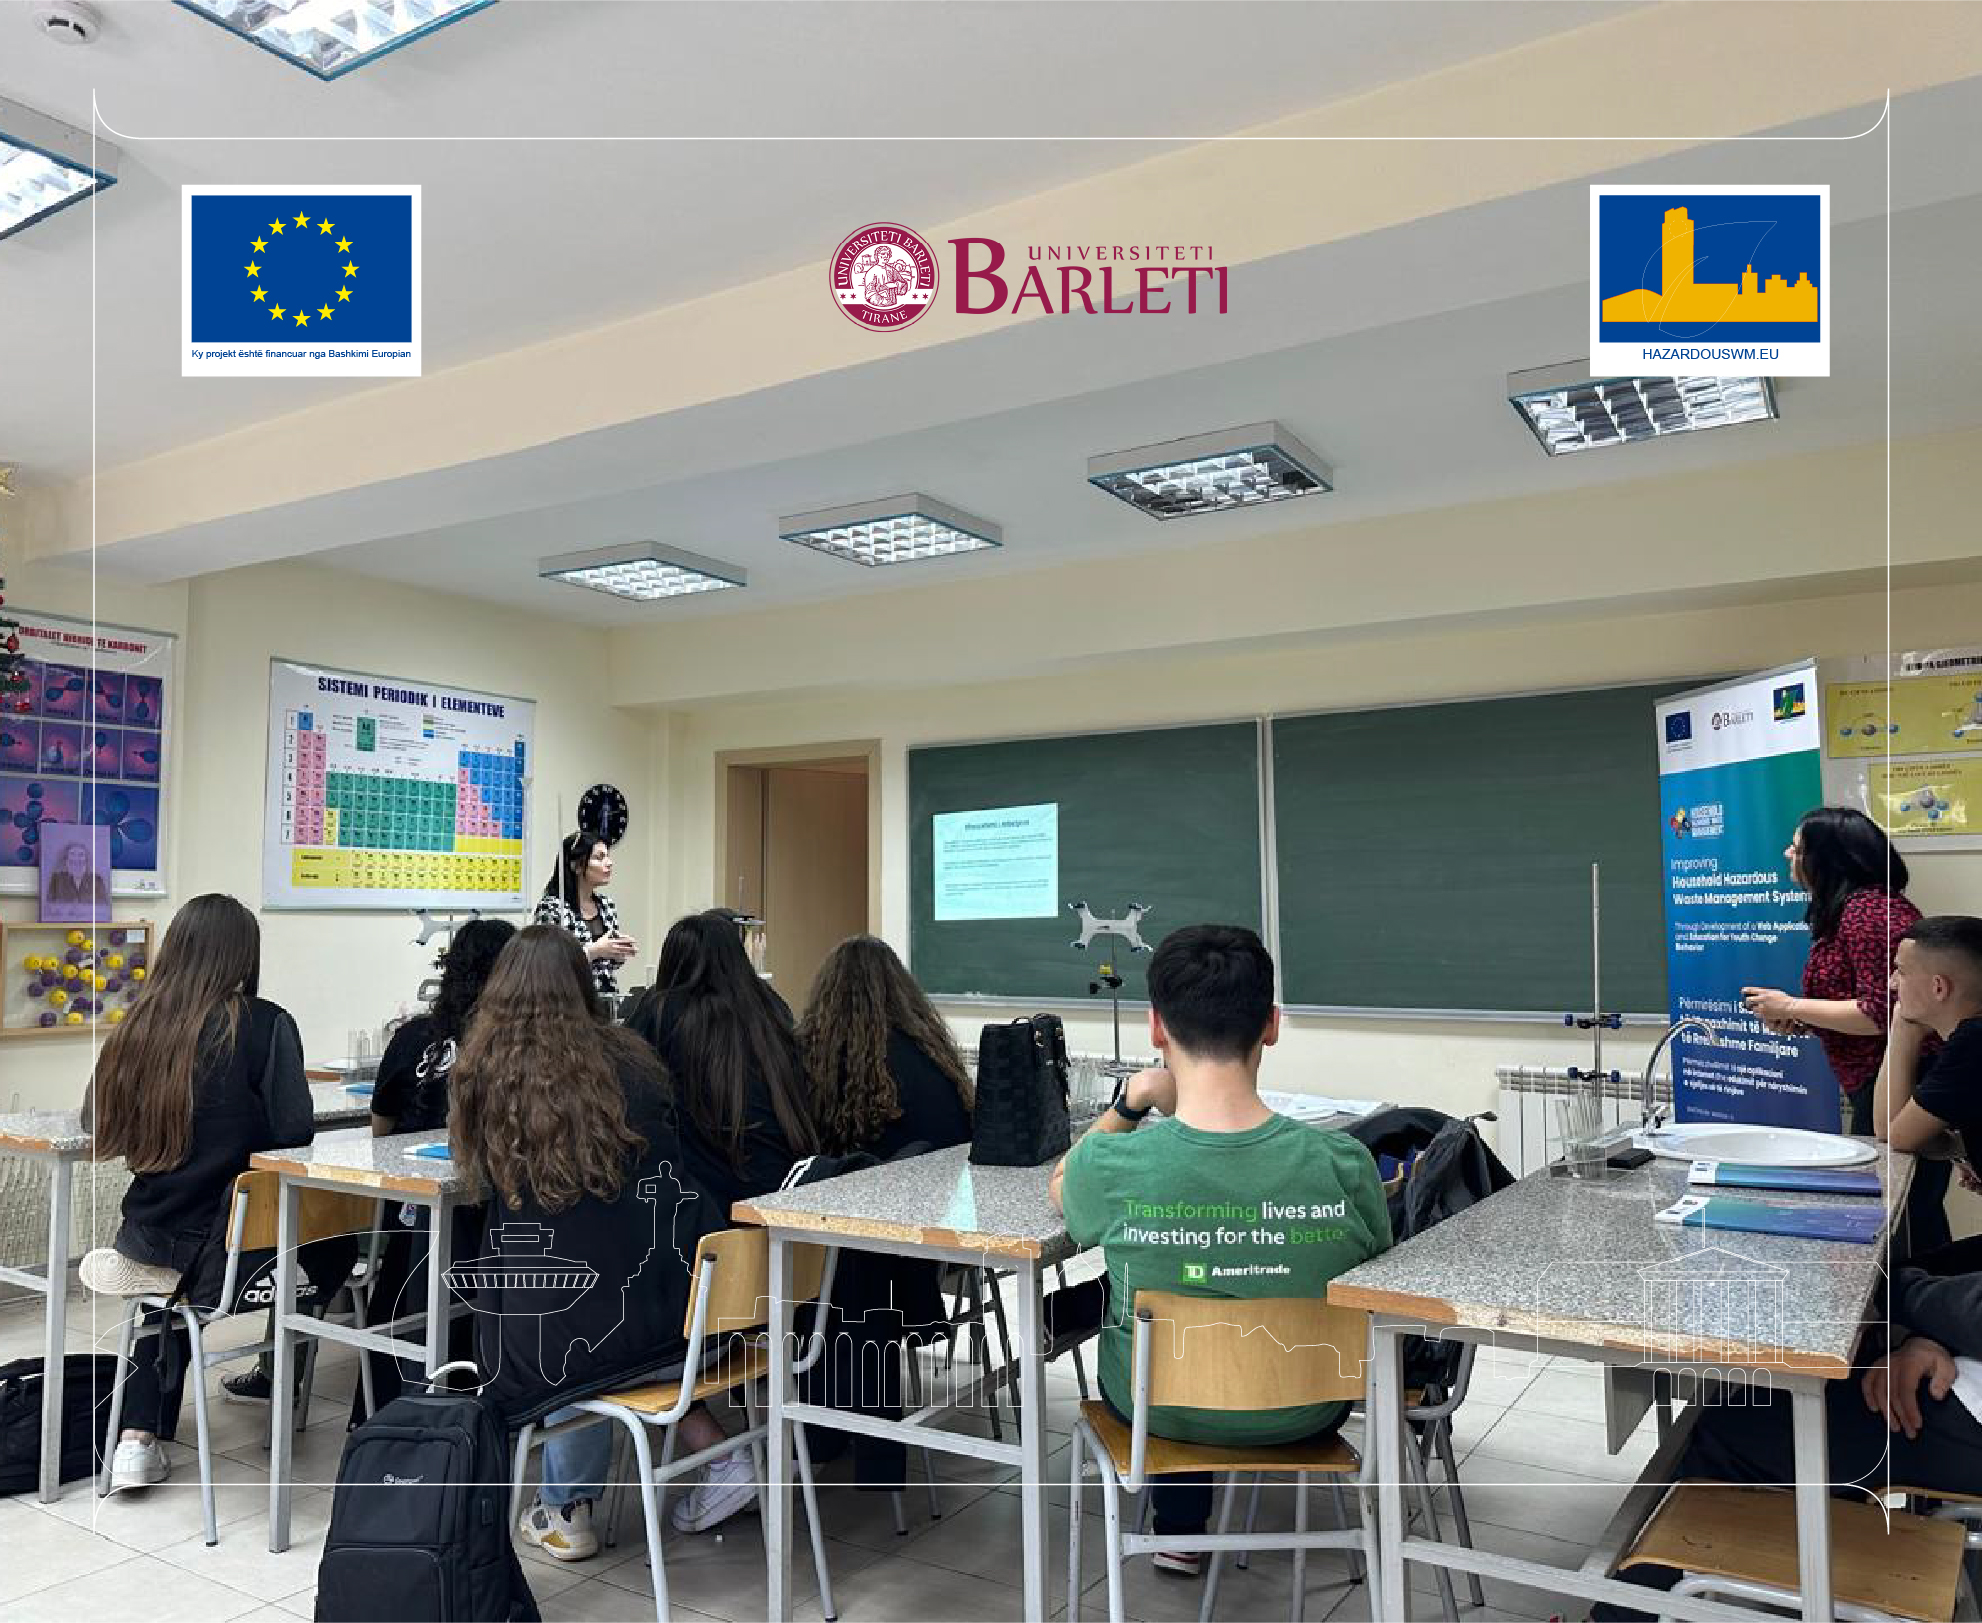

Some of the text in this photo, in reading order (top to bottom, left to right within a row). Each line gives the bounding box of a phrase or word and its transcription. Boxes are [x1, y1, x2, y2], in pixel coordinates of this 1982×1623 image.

[318, 676, 505, 718] SISTEMI PERIODIK I ELEMENTEVE
[1671, 858, 1717, 871] Improving
[1673, 871, 1778, 888] Household Hazardous
[1673, 893, 1703, 904] Waste
[1705, 891, 1770, 908] Management
[1749, 1040, 1799, 1059] Familjare
[1124, 1200, 1345, 1222] Transforming lives and
[1123, 1223, 1211, 1249] investing
[1215, 1226, 1247, 1245] for
[1251, 1228, 1286, 1245] the
[1185, 1263, 1292, 1279] TD Ameritrade
[244, 1285, 318, 1303] adas
